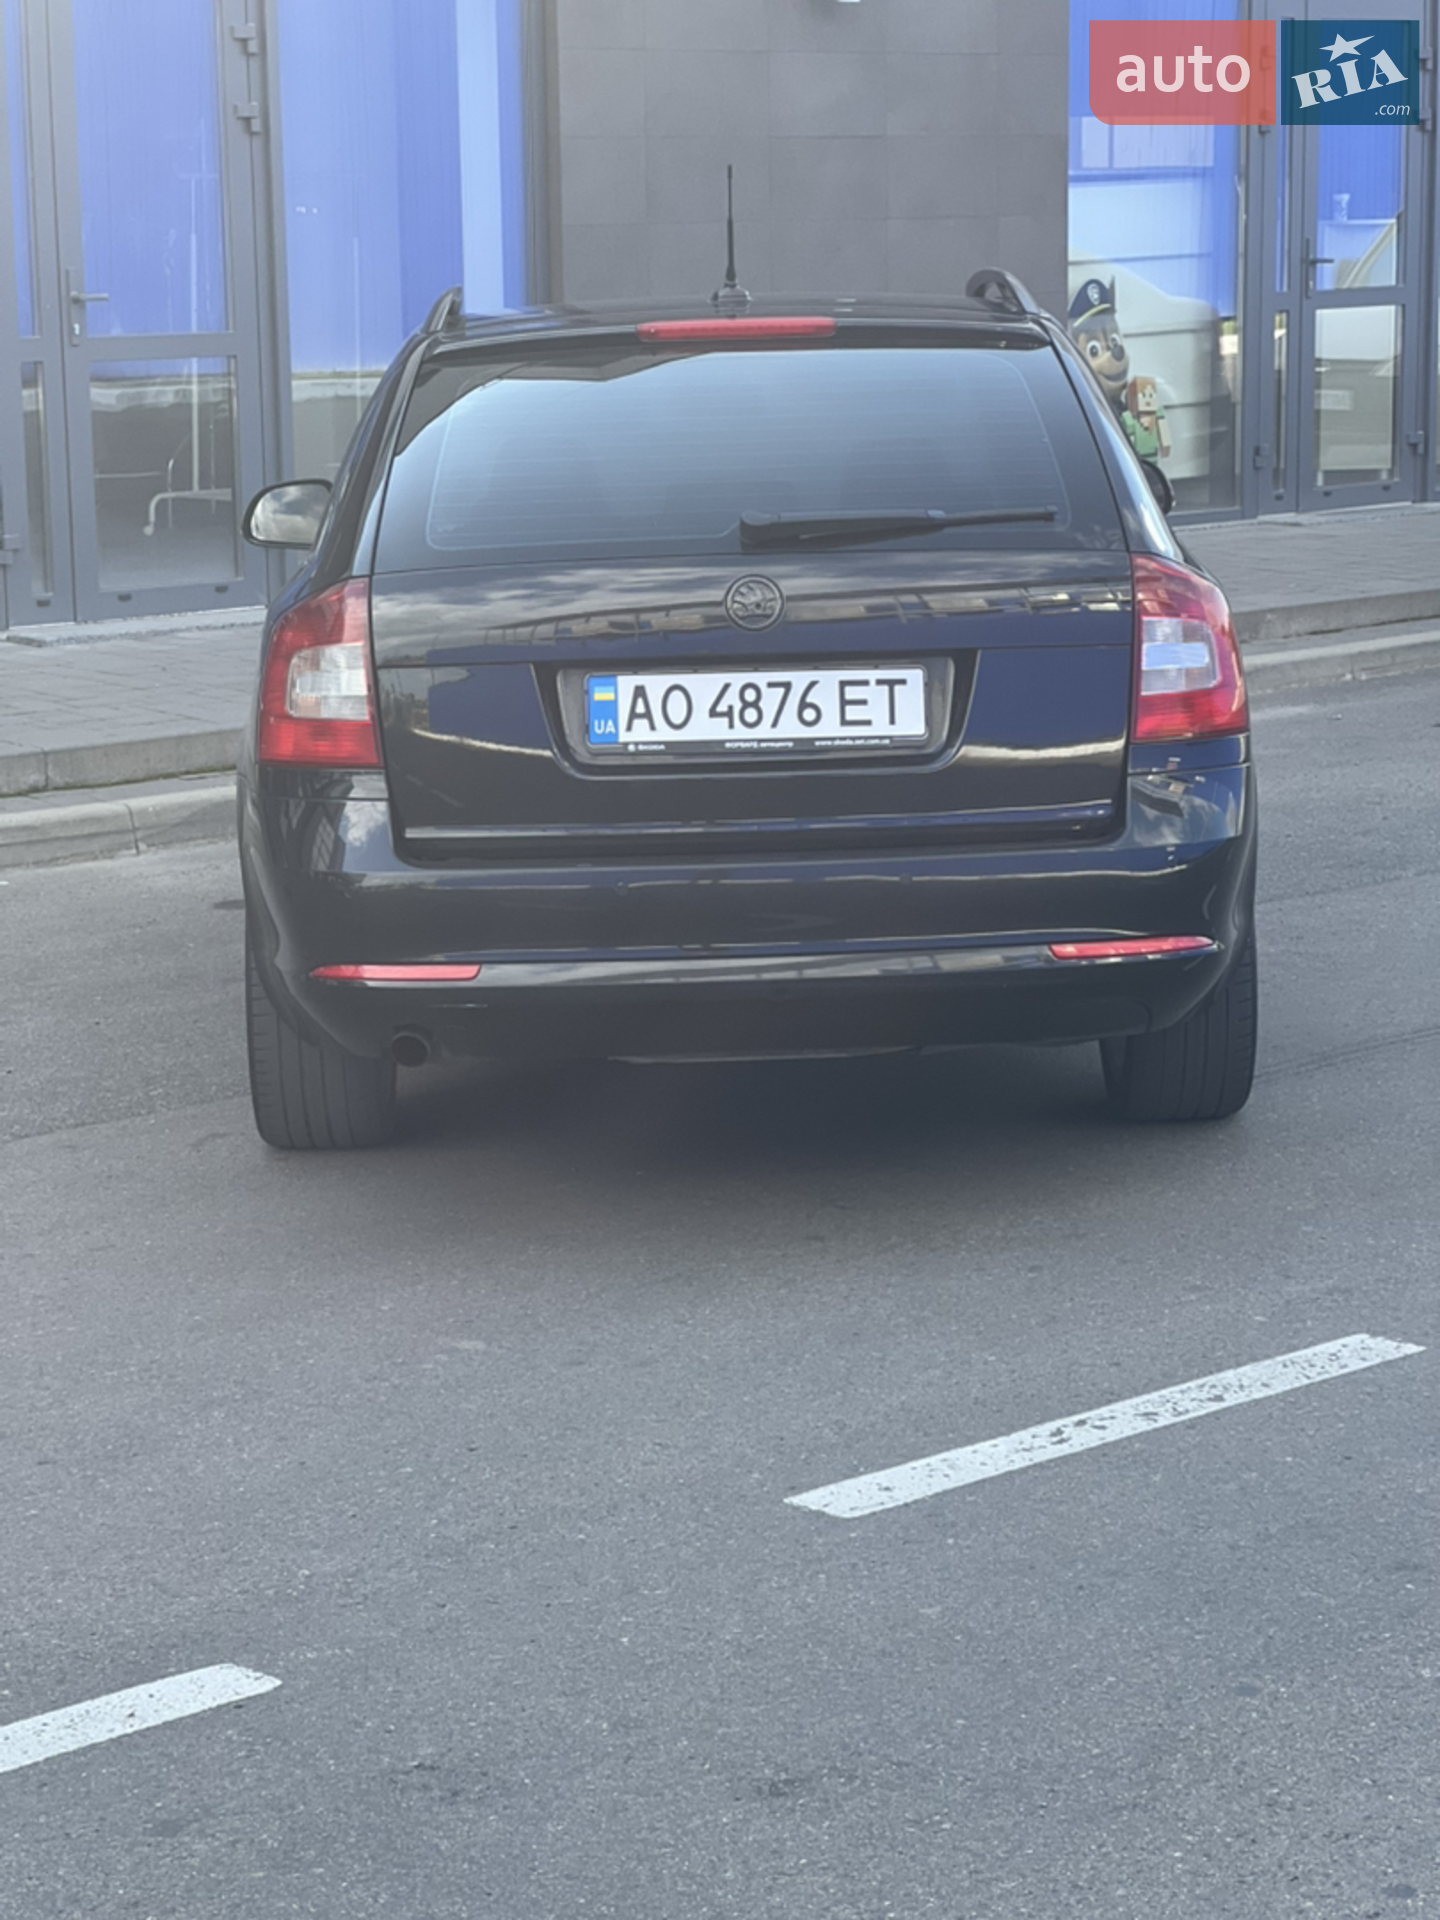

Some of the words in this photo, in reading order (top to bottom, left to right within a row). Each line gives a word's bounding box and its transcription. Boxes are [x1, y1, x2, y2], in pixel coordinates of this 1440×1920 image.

[625, 683, 693, 732] AO
[708, 680, 823, 730] 4876
[838, 678, 908, 727] ET
[594, 719, 616, 734] UA
